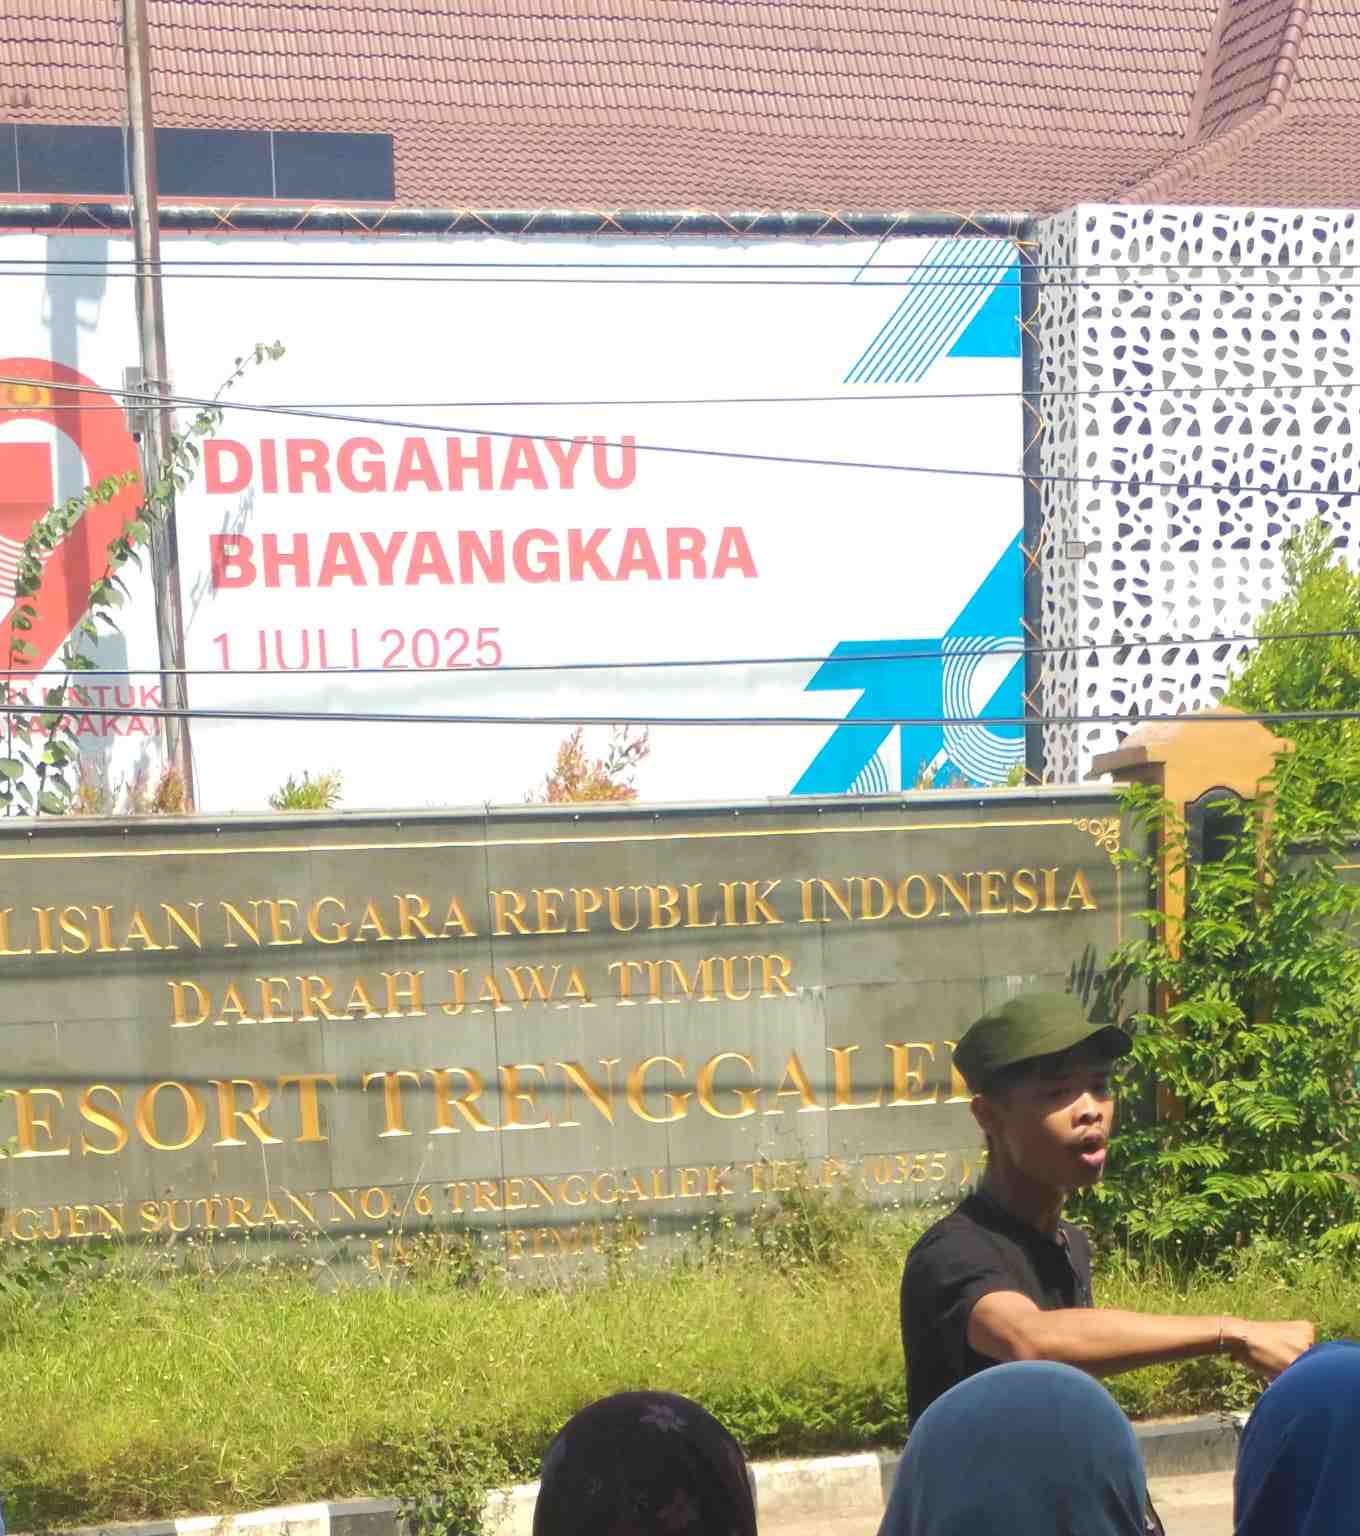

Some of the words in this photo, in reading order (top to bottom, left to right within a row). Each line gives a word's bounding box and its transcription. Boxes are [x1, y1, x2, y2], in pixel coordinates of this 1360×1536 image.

[203, 435, 637, 495] DIRGAHAYU
[207, 526, 759, 589] BHAYANGKARA
[212, 631, 232, 671] 1
[379, 627, 504, 669] 2025
[220, 894, 477, 949] NEGARA
[489, 879, 783, 936] REPUBLIK
[796, 867, 1099, 924] INDONESIA
[168, 970, 429, 1028] DAERAH
[439, 963, 597, 1016] JAWA
[607, 954, 799, 1007] TIMUR
[414, 1183, 434, 1216] 6
[443, 1161, 737, 1214] TRENGGALEK
